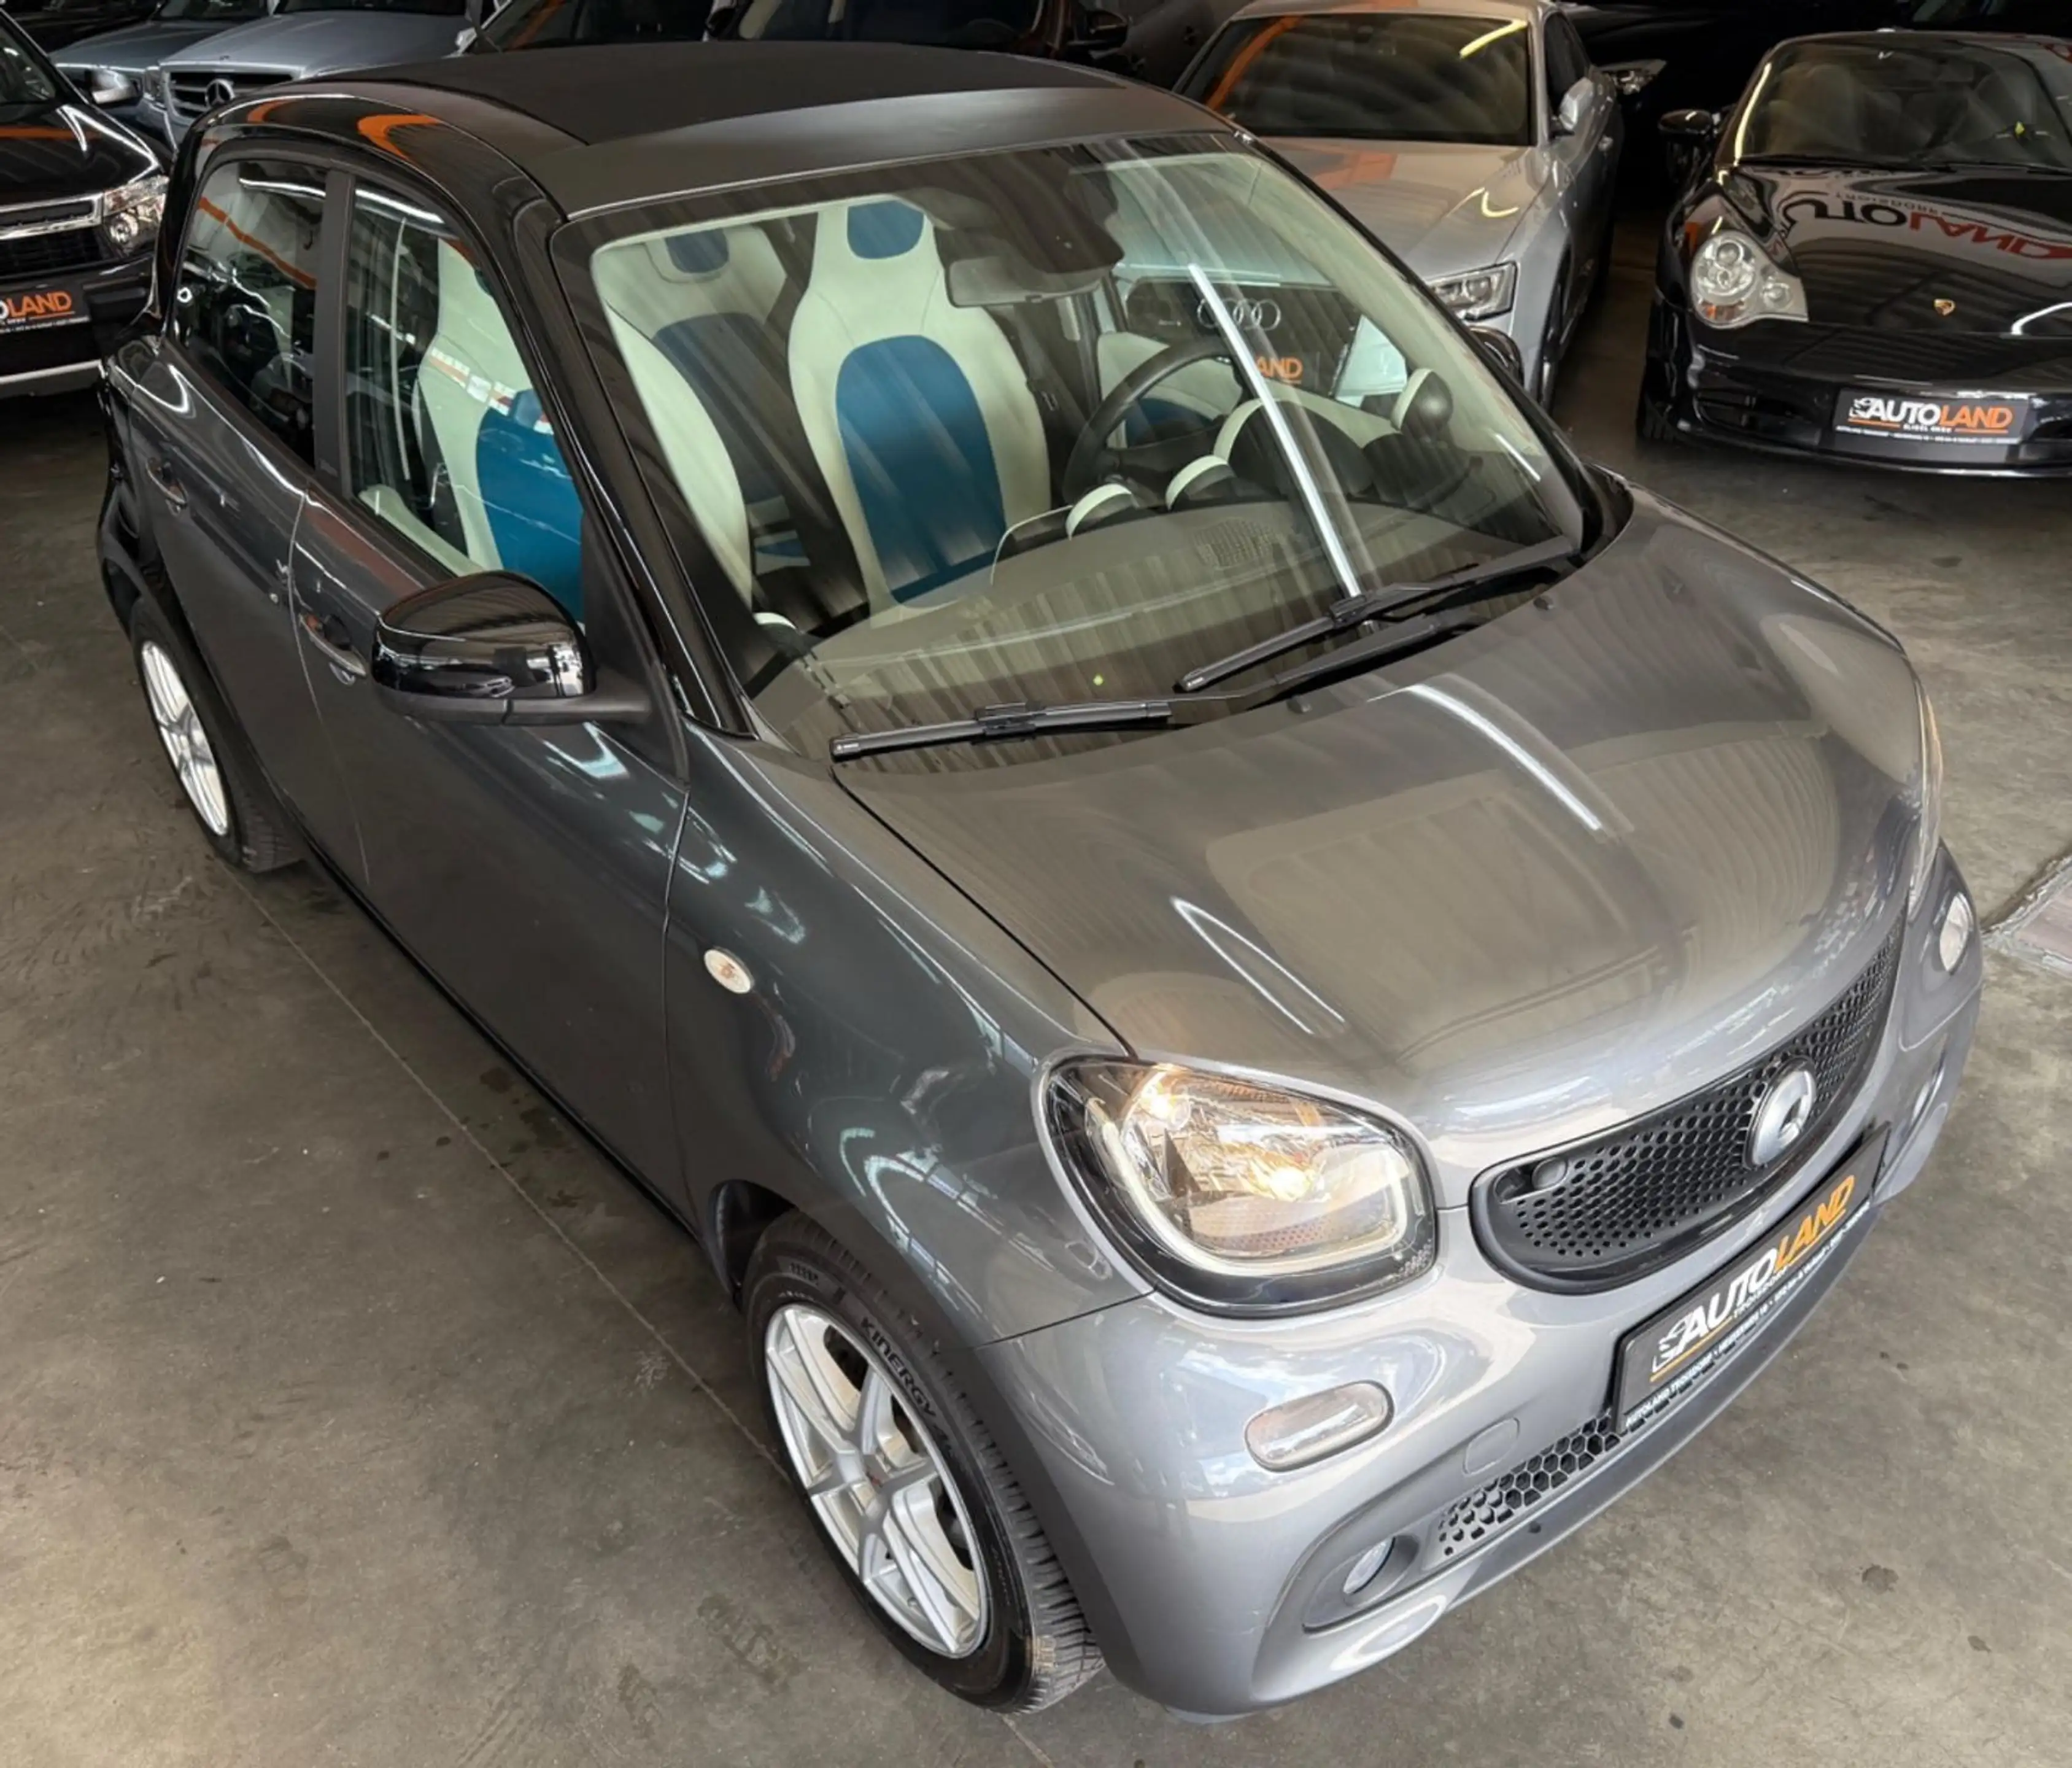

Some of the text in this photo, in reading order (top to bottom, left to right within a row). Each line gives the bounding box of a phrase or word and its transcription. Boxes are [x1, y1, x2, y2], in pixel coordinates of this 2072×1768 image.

[1255, 355, 1303, 378] AND
[1866, 398, 2013, 428] AUTOLAND
[1674, 1175, 1855, 1357] AUTOLAND
[861, 1317, 936, 1416] KINERGY
